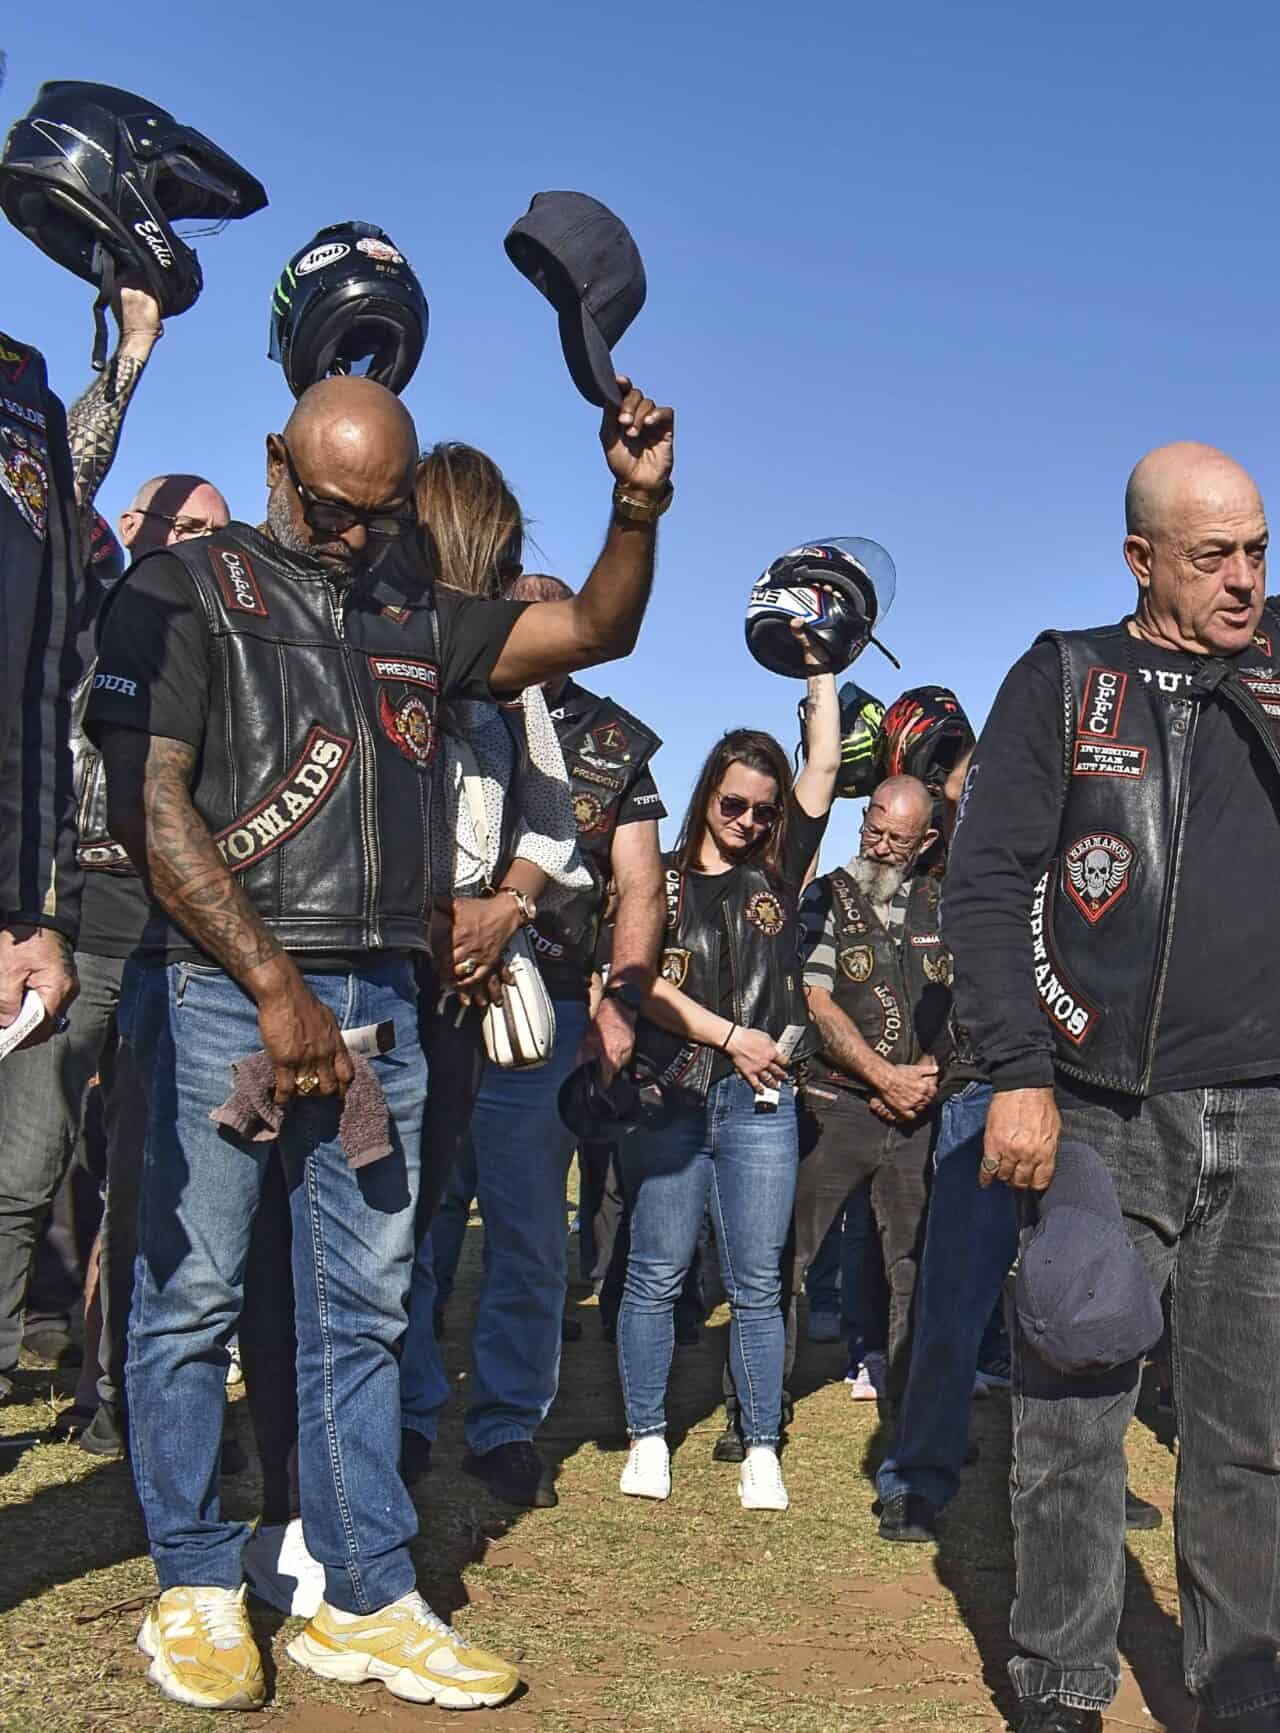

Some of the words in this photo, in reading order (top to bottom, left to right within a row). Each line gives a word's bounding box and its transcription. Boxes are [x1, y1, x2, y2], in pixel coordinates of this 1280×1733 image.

[134, 220, 172, 268] Eddie
[302, 244, 347, 272] Arai
[375, 662, 437, 683] PRESIDENT
[1071, 837, 1130, 860] HERMANOS
[875, 984, 902, 1042] COAST
